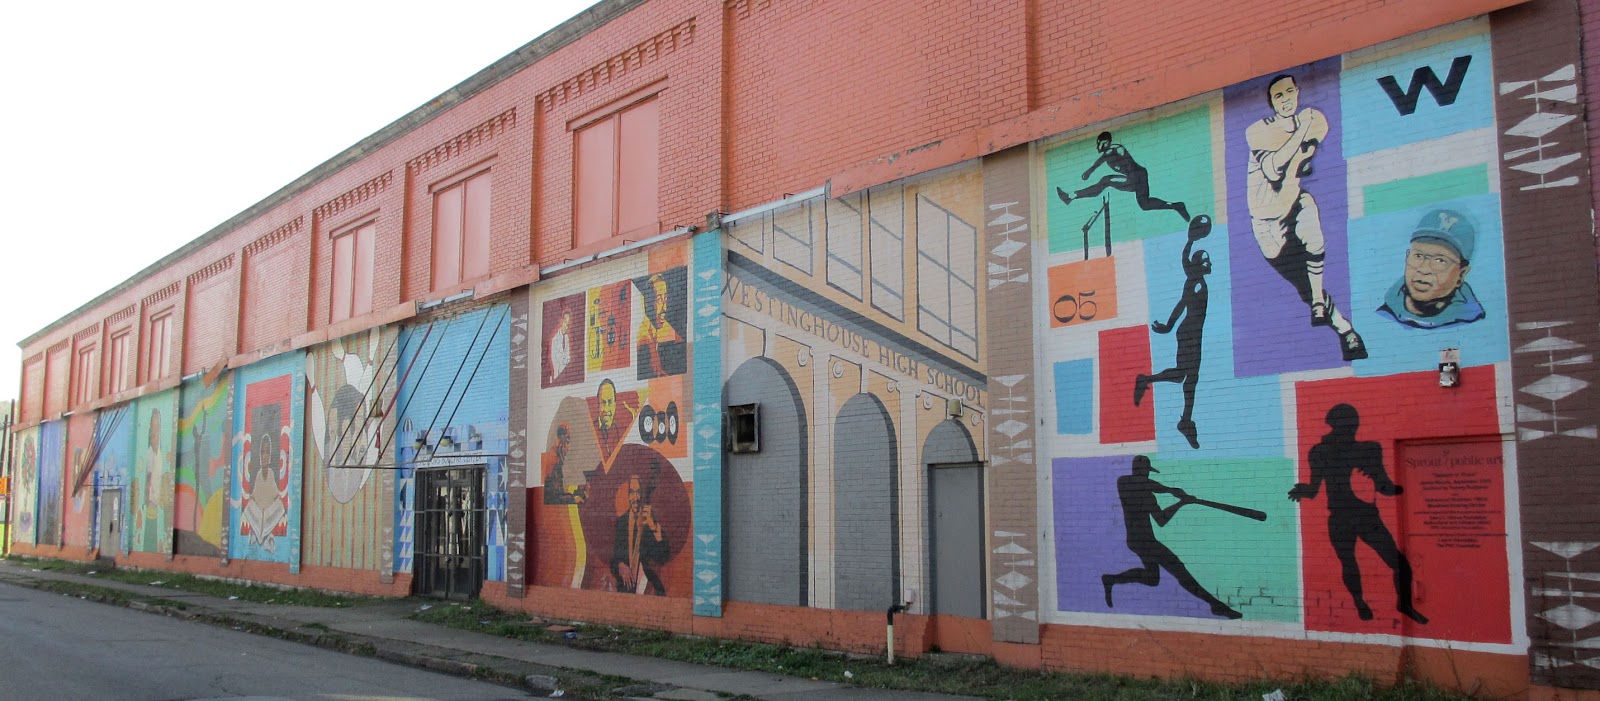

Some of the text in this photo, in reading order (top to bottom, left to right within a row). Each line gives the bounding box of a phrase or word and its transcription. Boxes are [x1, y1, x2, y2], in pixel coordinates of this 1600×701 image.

[1376, 54, 1472, 117] W
[720, 273, 986, 410] WESTINGHOUSE HIGH SCHOOL
[1450, 455, 1485, 468] public
